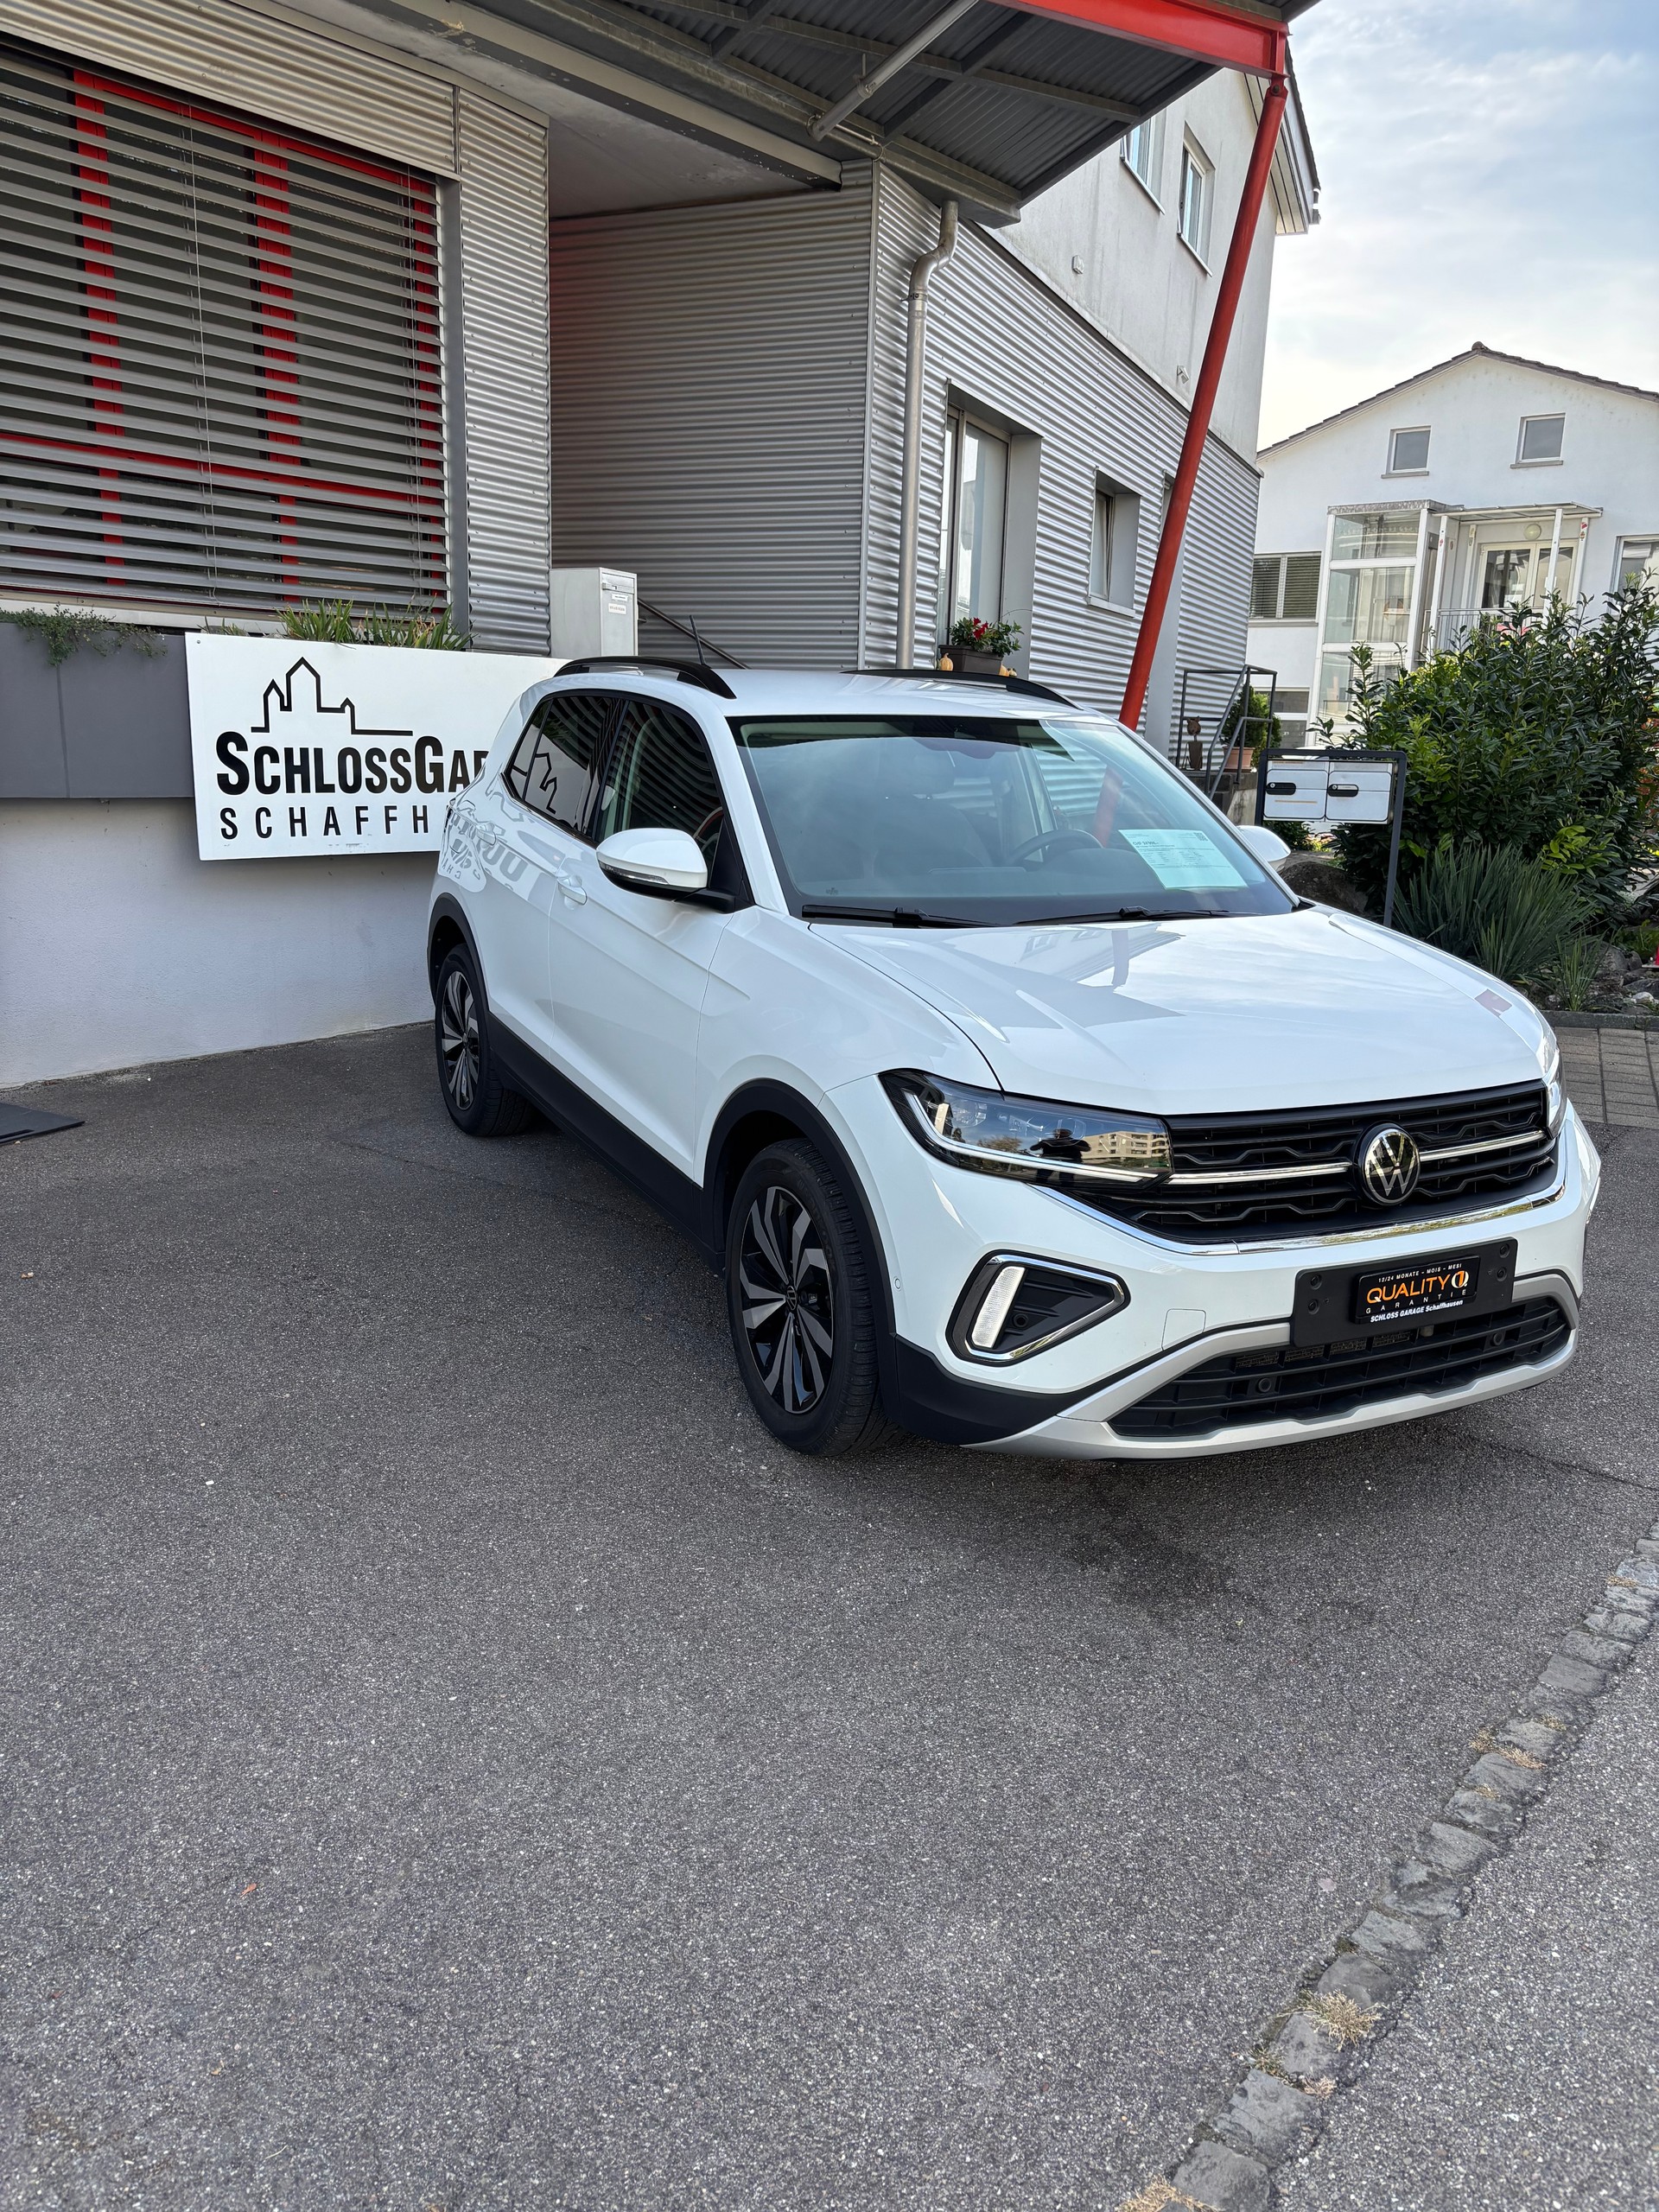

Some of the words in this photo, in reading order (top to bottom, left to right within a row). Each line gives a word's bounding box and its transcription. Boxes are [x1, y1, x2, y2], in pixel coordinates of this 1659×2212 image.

[219, 804, 448, 840] SCHAFFH
[1396, 1270, 1420, 1280] MONATE
[1365, 1289, 1466, 1314] GARANTIE
[1370, 1311, 1399, 1323] SCHLOSS
[1400, 1306, 1425, 1318] GARAGE
[1426, 1300, 1464, 1313] Schaffhausen
